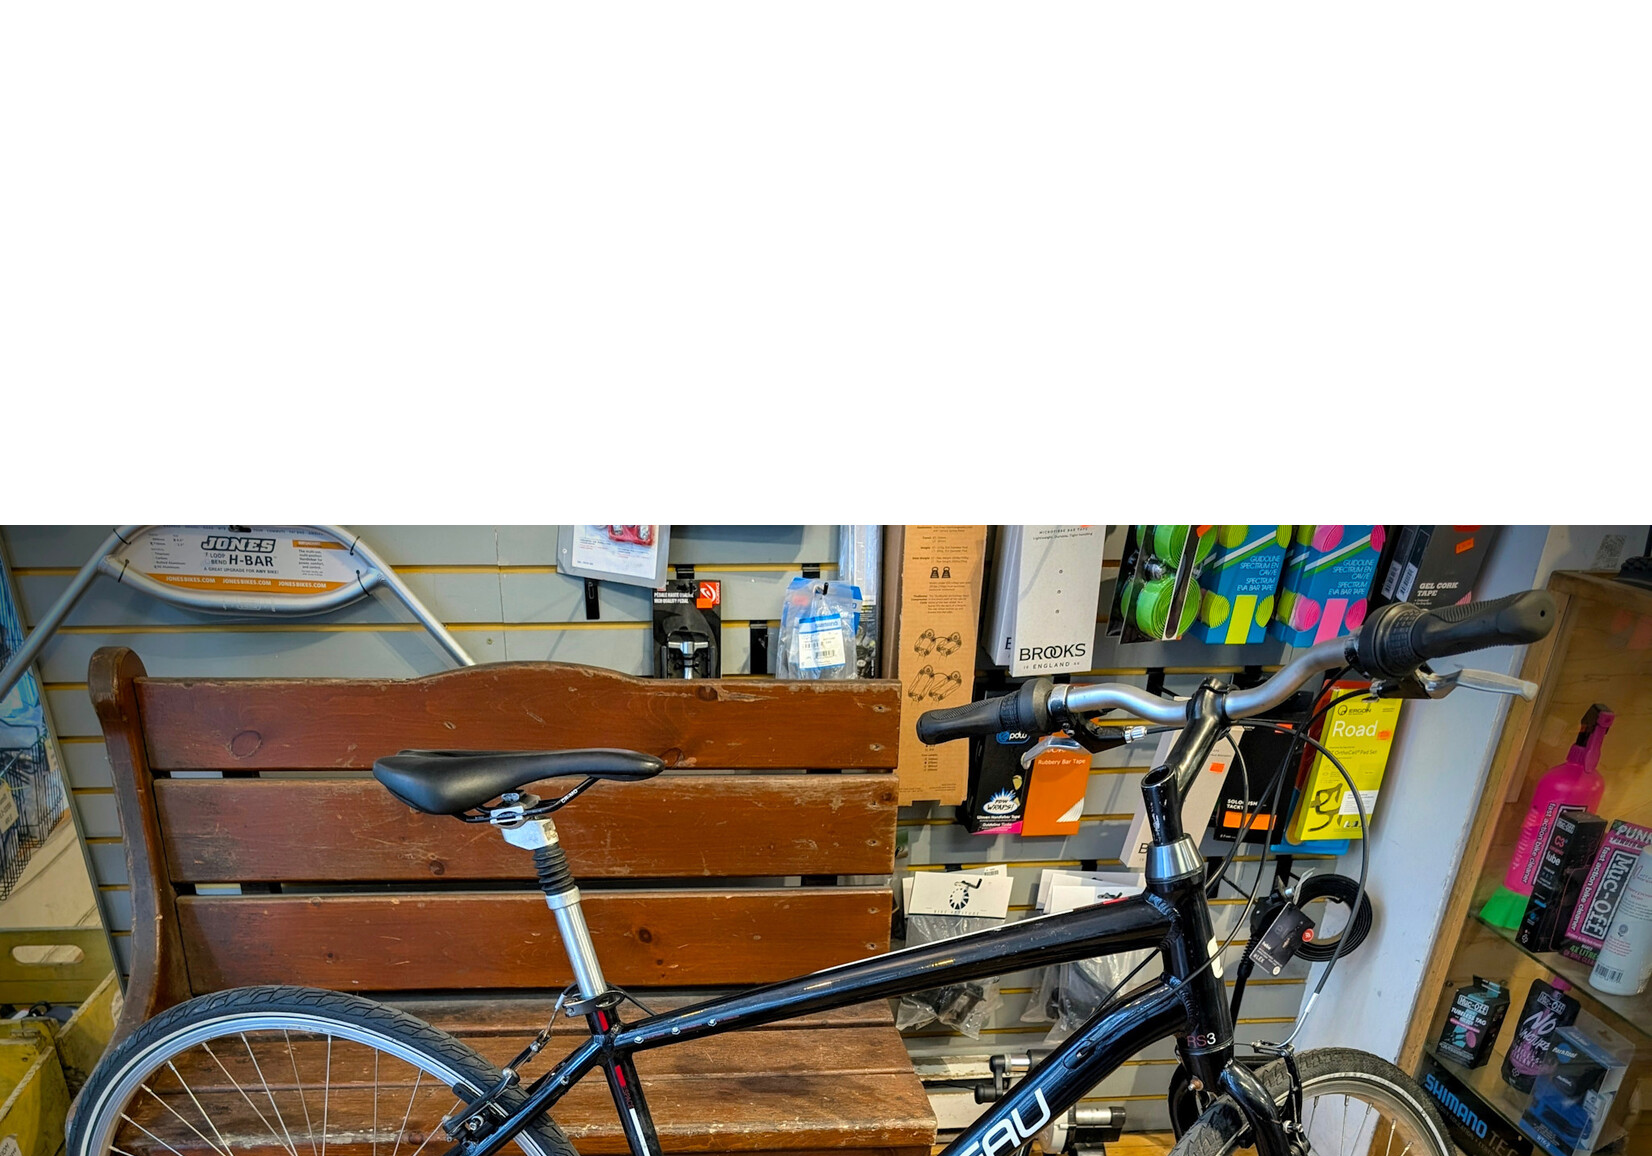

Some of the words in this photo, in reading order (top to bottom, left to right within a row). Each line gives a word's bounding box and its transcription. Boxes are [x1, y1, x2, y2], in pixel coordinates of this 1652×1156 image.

[202, 535, 276, 554] JONES
[229, 554, 274, 567] H-BAR
[166, 575, 216, 583] JONESBIKES.COM
[223, 577, 271, 586] JONESBIKES.COM
[278, 580, 326, 588] JONESBIKES.COM
[1419, 582, 1435, 590] GEL
[1436, 581, 1459, 589] CORK
[1019, 643, 1086, 661] BROOKS
[1033, 661, 1070, 669] ENGLAND
[1008, 731, 1028, 741] pdw
[1332, 720, 1378, 737] Road
[1547, 803, 1556, 817] fast
[1539, 818, 1550, 841] action
[1532, 841, 1543, 858] bike
[1599, 846, 1611, 861] fast
[1522, 858, 1536, 884] cleaner
[1589, 861, 1602, 885] action
[1581, 885, 1593, 903] bike
[1586, 854, 1635, 937] Muc-Off
[1572, 902, 1585, 931] cleaner
[1570, 944, 1578, 953] 4X
[1451, 1007, 1475, 1021] TUBELESS
[1475, 1016, 1487, 1026] TAG
[1523, 1011, 1556, 1035] NO
[1186, 1032, 1216, 1048] RS3
[1424, 1073, 1488, 1139] SHIMANO
